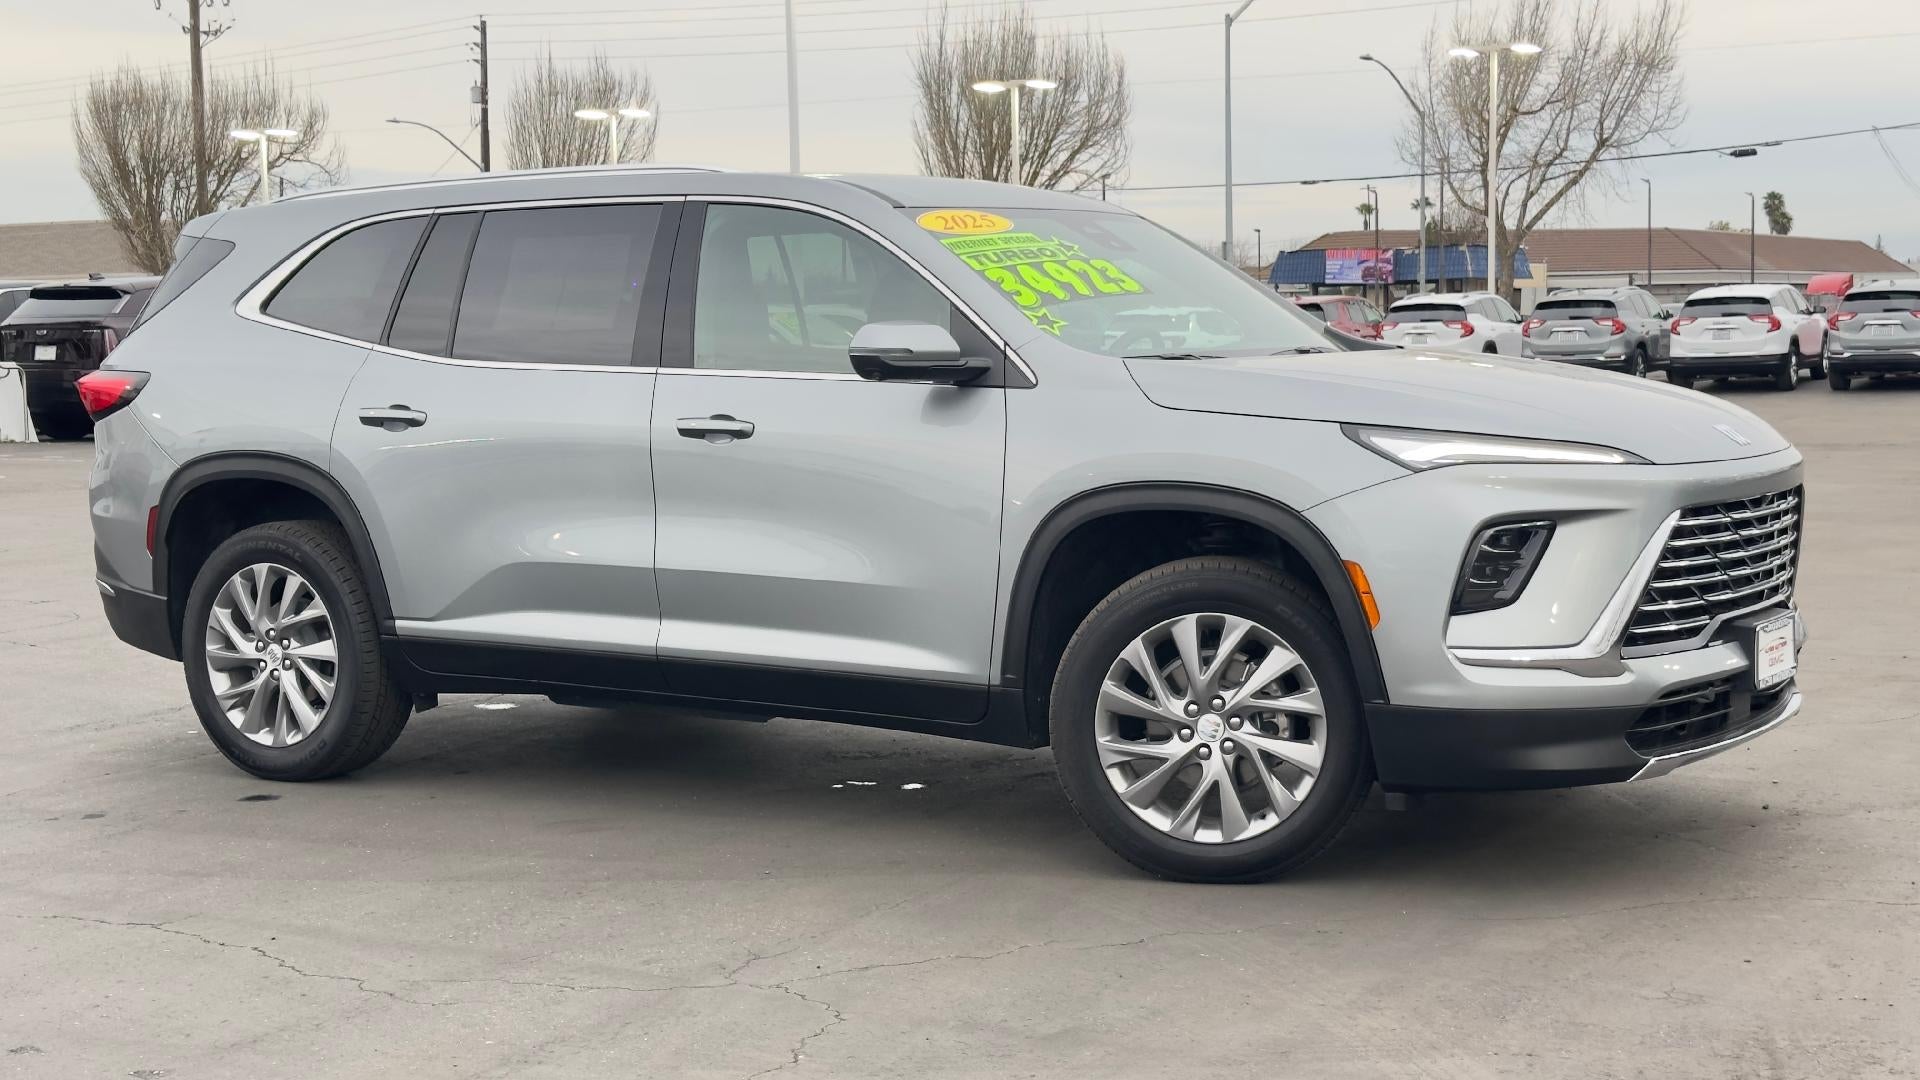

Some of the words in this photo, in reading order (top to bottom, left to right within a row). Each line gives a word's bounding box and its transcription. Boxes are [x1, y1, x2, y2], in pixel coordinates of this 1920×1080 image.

[938, 214, 997, 231] 2025
[947, 237, 998, 251] INTERNET
[966, 247, 1058, 267] TURBO
